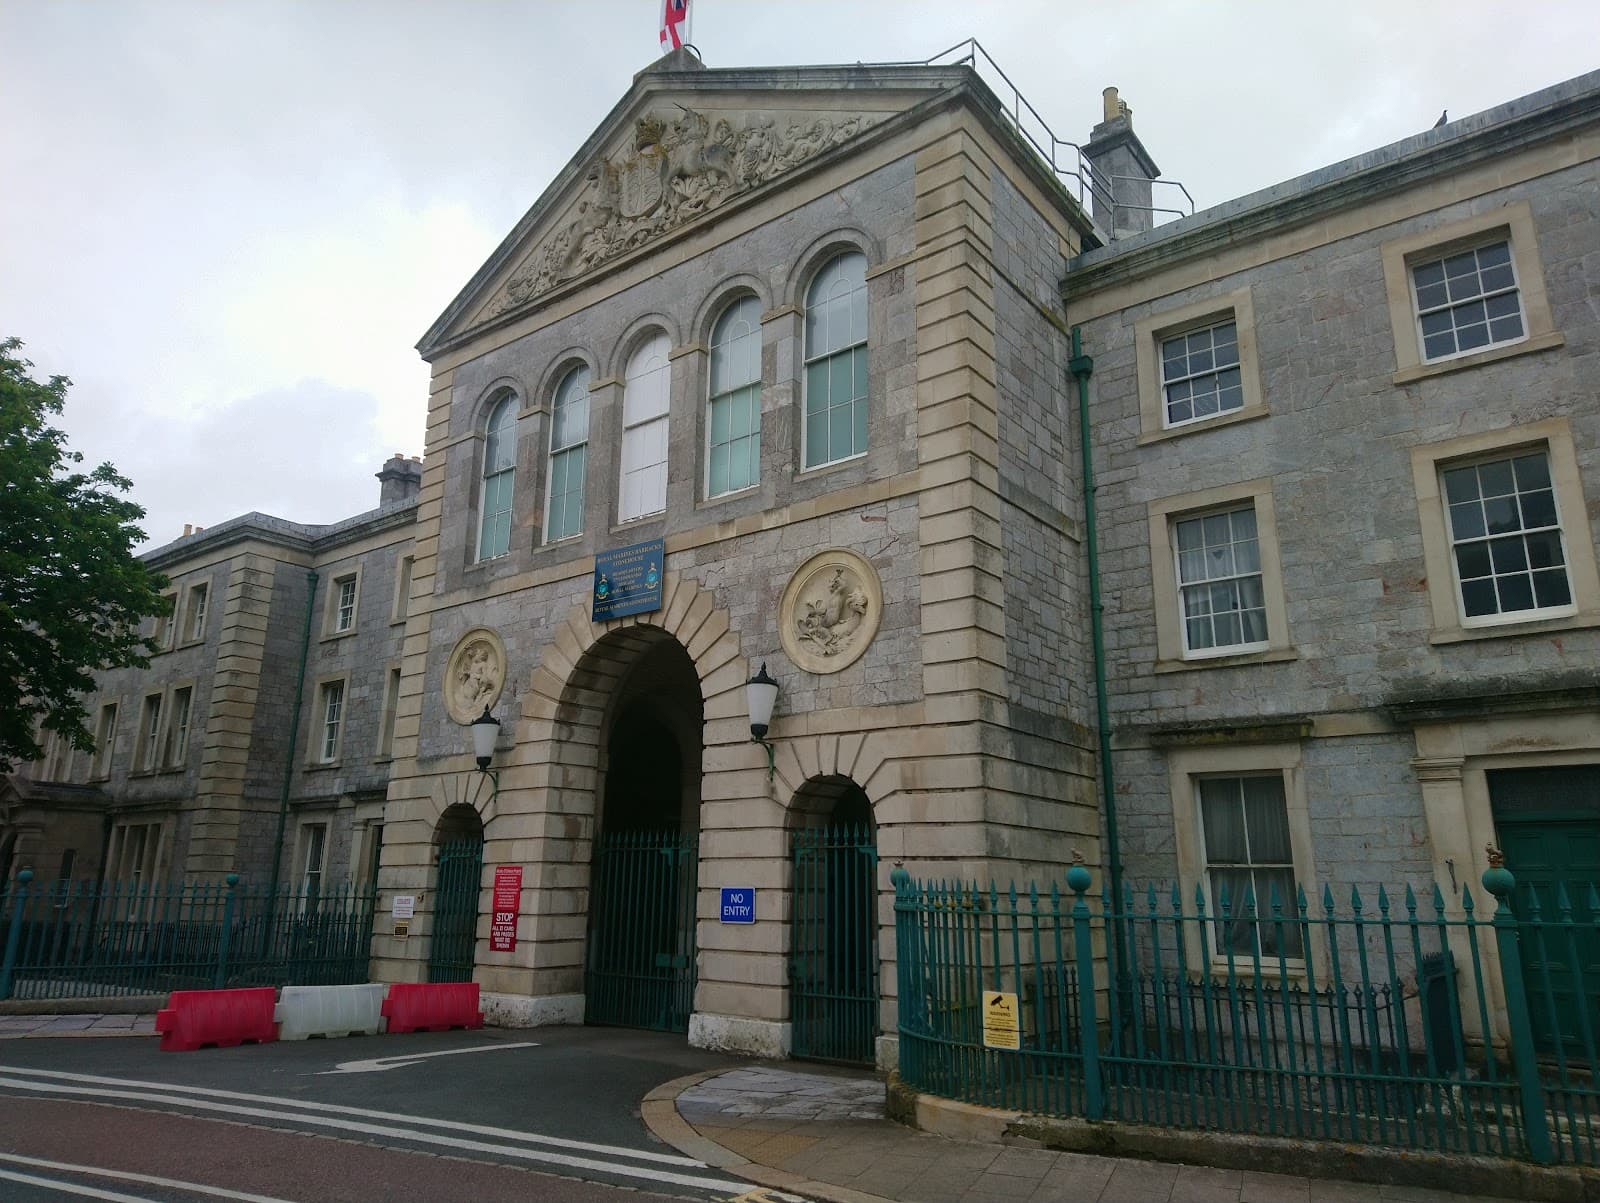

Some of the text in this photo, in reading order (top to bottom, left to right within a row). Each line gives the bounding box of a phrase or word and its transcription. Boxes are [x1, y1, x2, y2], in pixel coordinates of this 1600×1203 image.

[731, 894, 744, 903] NO
[724, 906, 750, 916] ENTRY
[496, 913, 513, 922] STOP
